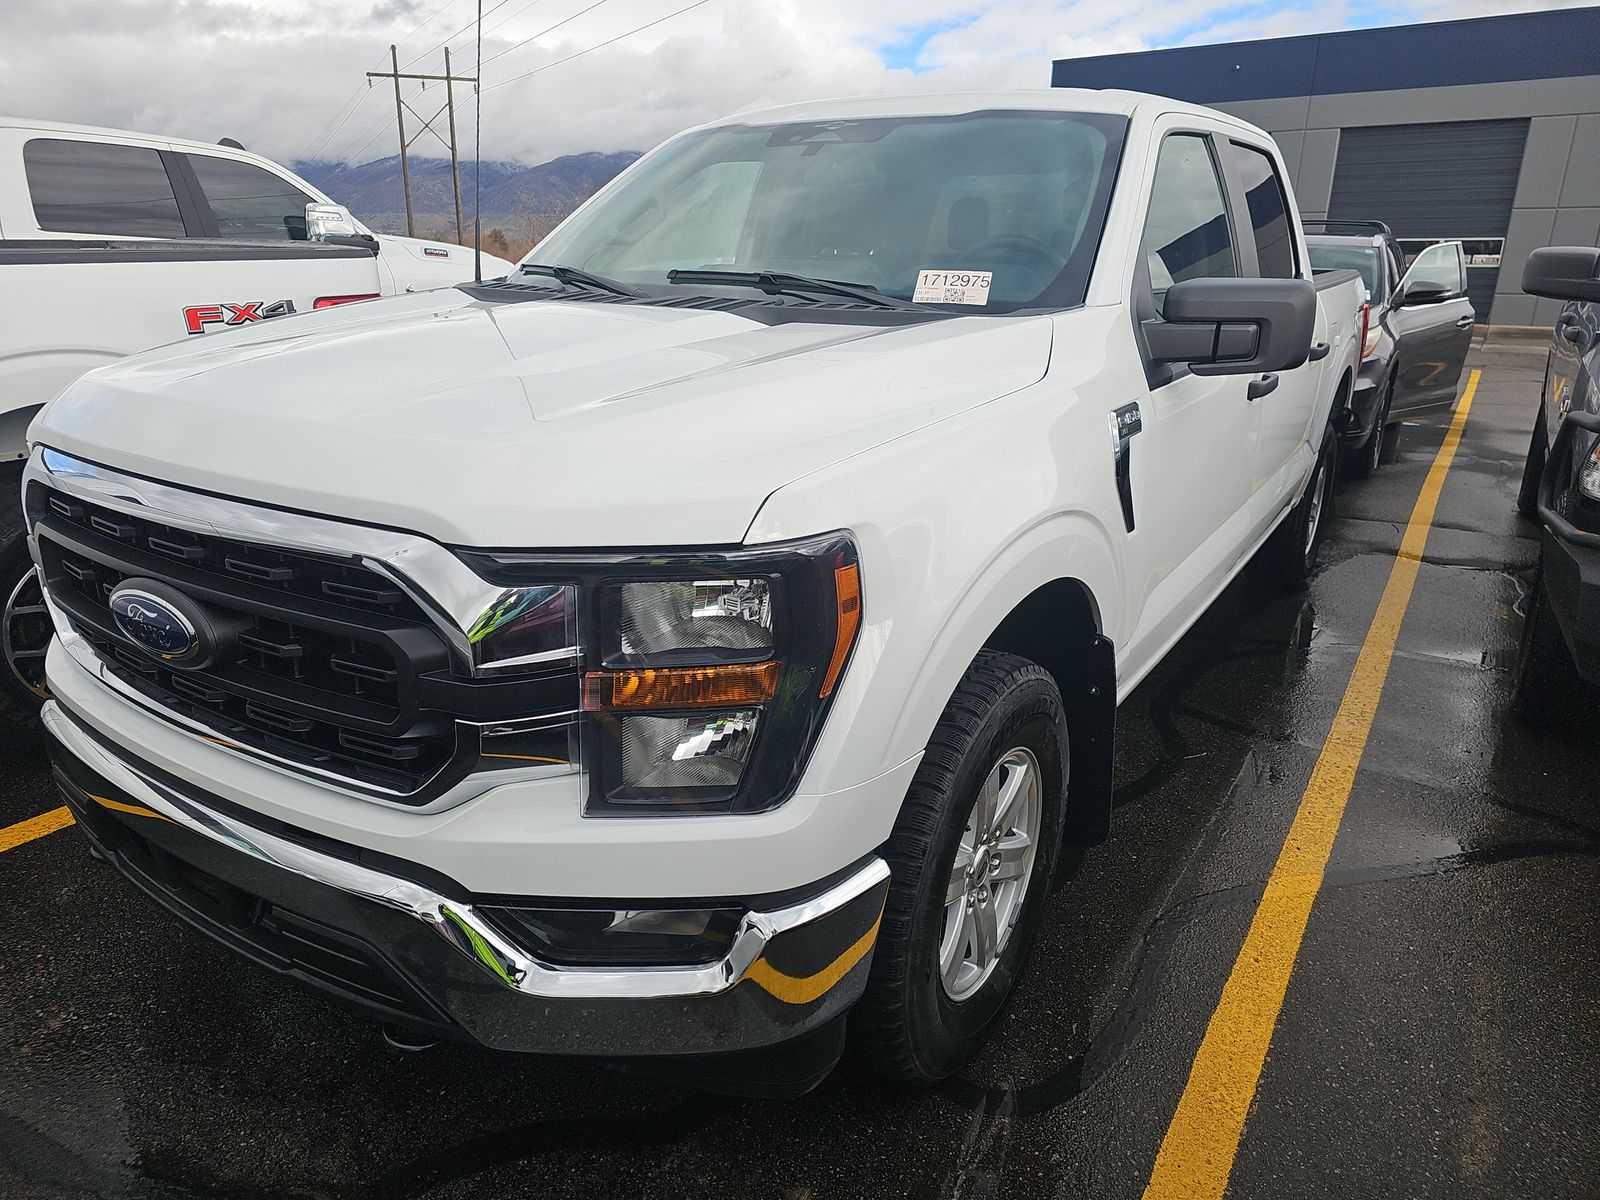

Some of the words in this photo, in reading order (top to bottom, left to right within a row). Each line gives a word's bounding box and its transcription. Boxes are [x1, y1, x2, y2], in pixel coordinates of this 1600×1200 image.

[922, 273, 990, 289] 1712975
[182, 299, 298, 335] FX4
[126, 603, 172, 648] Ford
